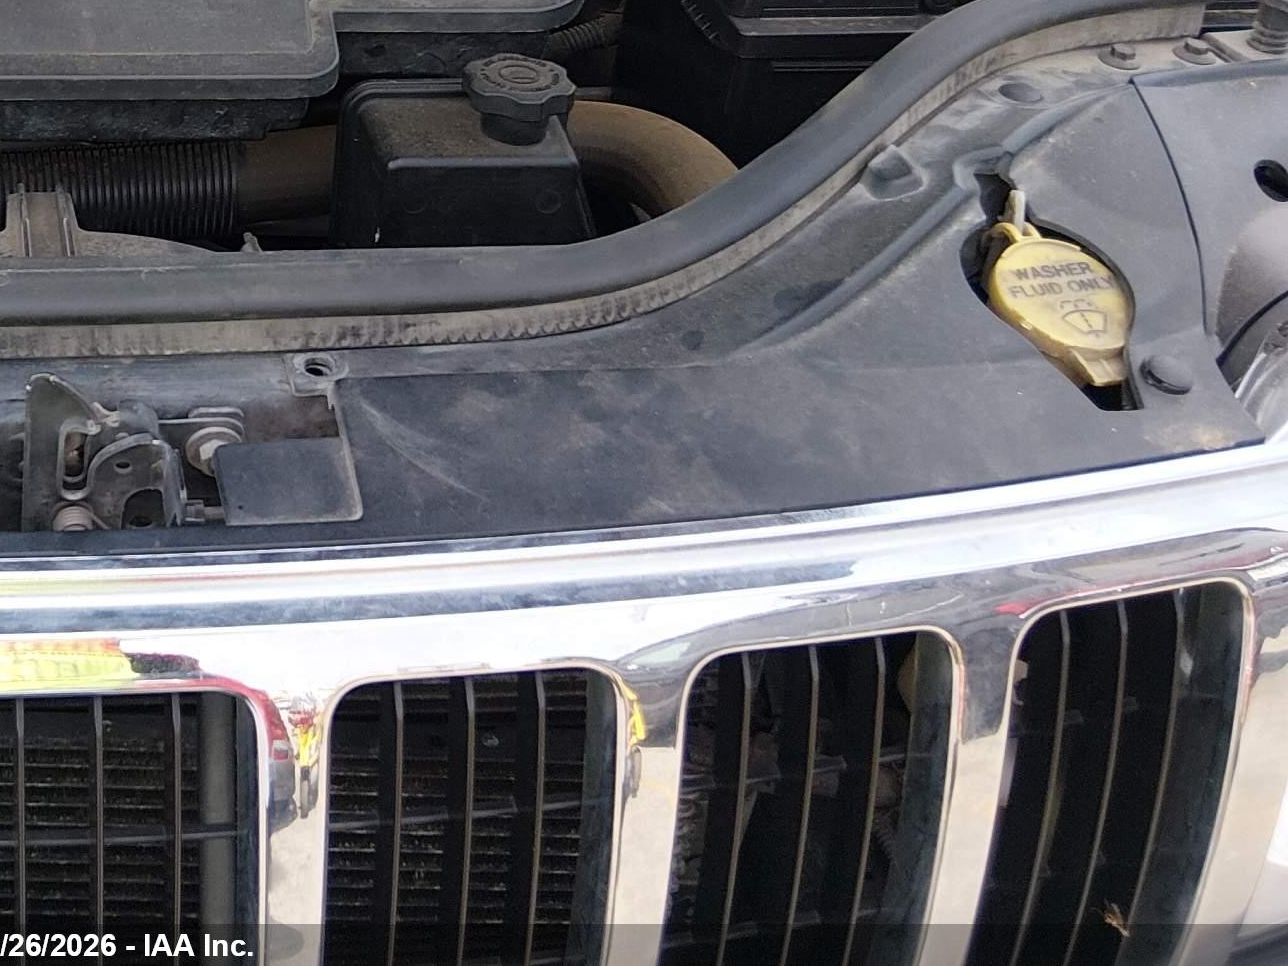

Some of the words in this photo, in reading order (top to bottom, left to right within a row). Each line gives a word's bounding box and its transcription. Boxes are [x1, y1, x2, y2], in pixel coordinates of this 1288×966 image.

[1015, 262, 1094, 280] WASHER
[1009, 281, 1063, 298] FLUID
[1067, 275, 1115, 292] ONLY
